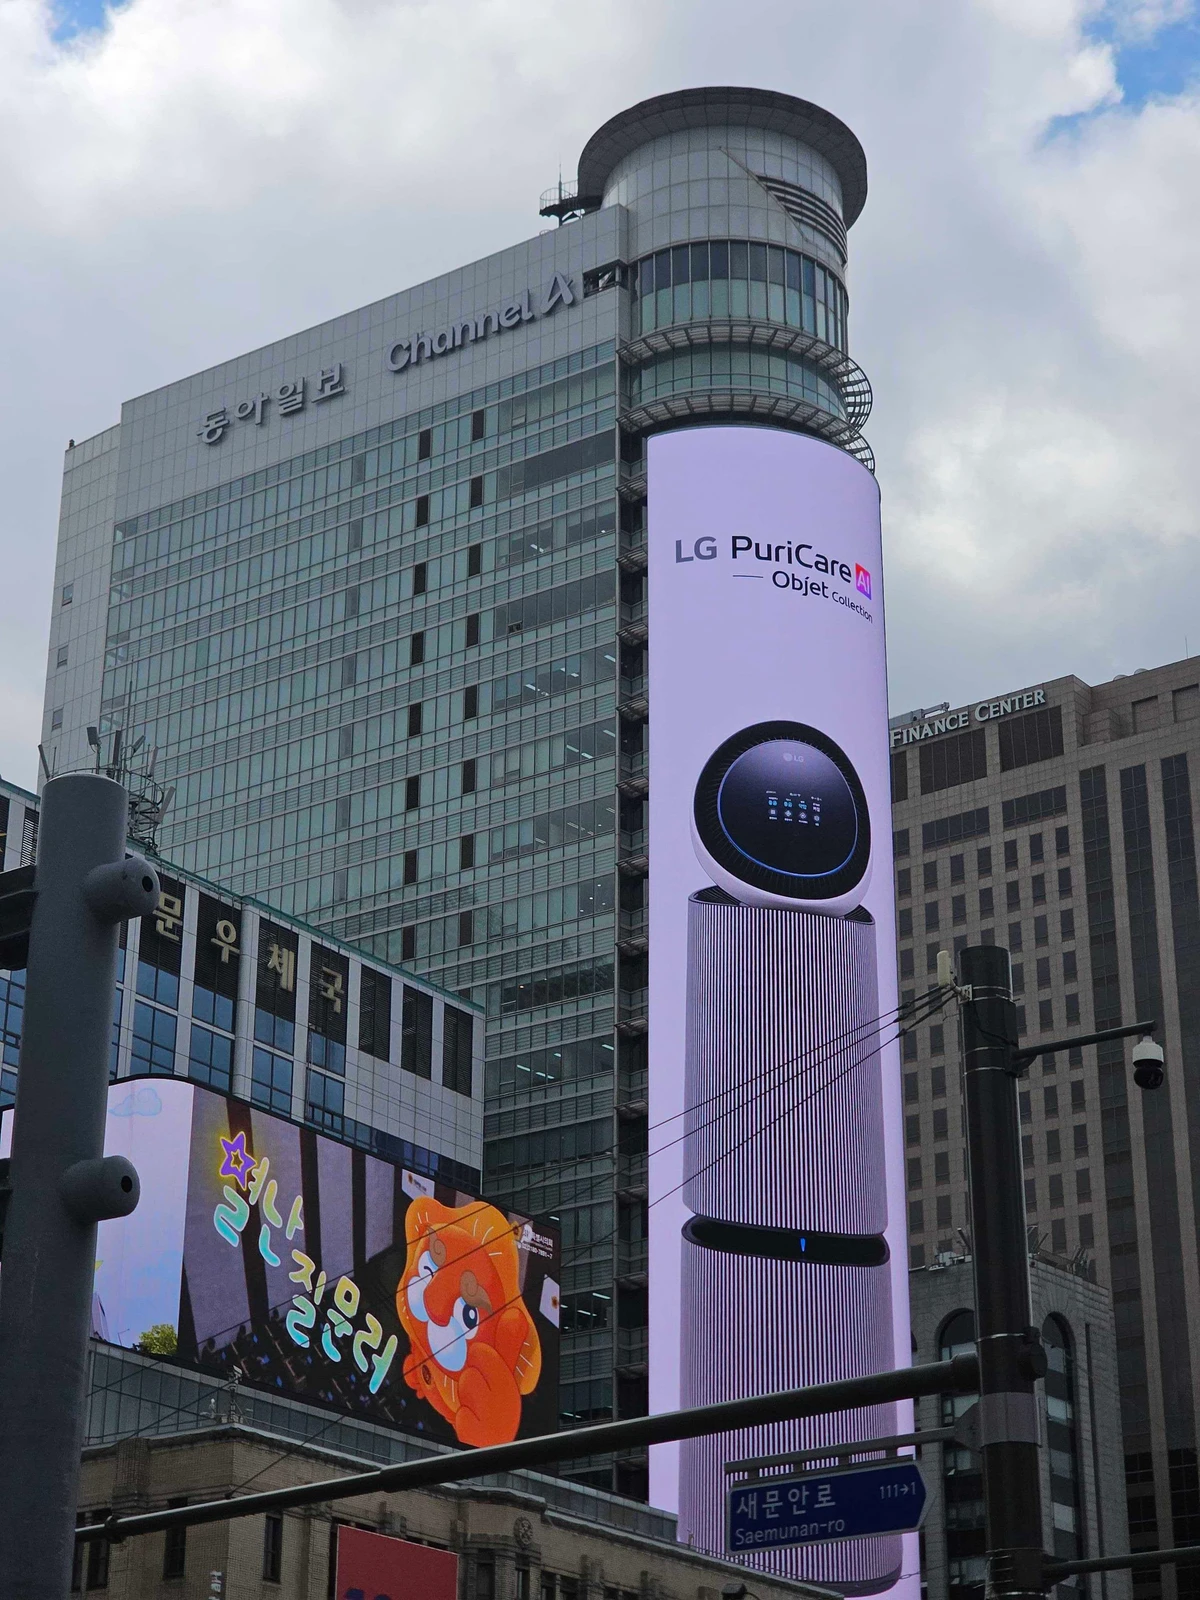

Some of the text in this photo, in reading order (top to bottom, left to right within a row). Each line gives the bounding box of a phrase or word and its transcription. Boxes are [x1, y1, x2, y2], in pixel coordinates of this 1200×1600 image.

[386, 271, 577, 372] Channel A
[197, 361, 346, 445] 동아일보
[675, 536, 718, 564] LG
[731, 535, 852, 583] PuriCare
[771, 570, 873, 624] Objet Collection
[890, 689, 1046, 748] FINANCE CENTER
[736, 1484, 836, 1520] 새문안로
[735, 1519, 846, 1546] Saemunan-ro
